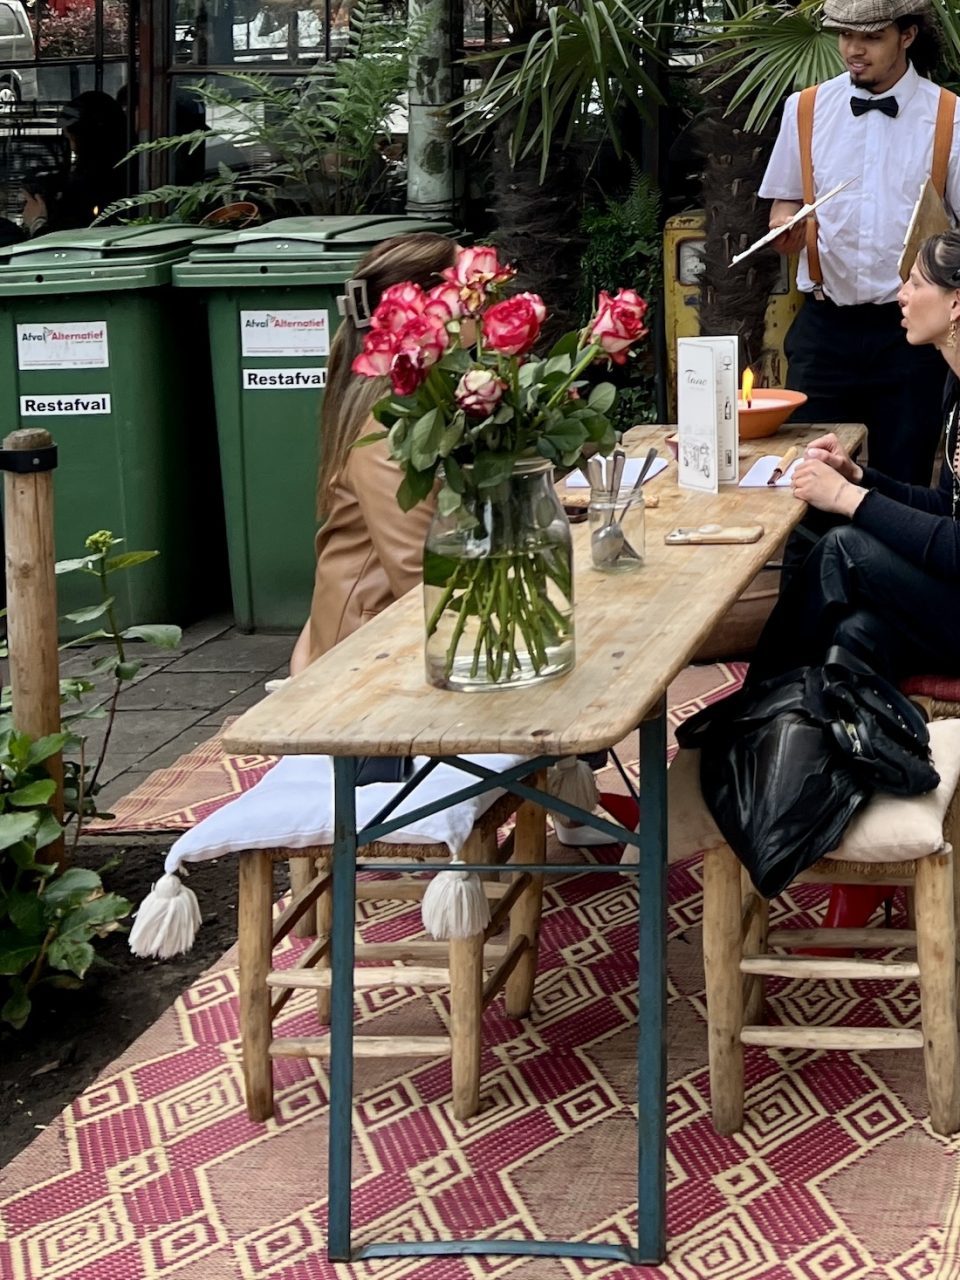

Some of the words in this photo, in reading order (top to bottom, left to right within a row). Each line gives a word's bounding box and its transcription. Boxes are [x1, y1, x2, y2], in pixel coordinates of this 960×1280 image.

[273, 318, 325, 328] Alternatief
[51, 330, 104, 341] Alternatief
[247, 371, 326, 386] Restafval
[24, 397, 106, 412] Restafval
